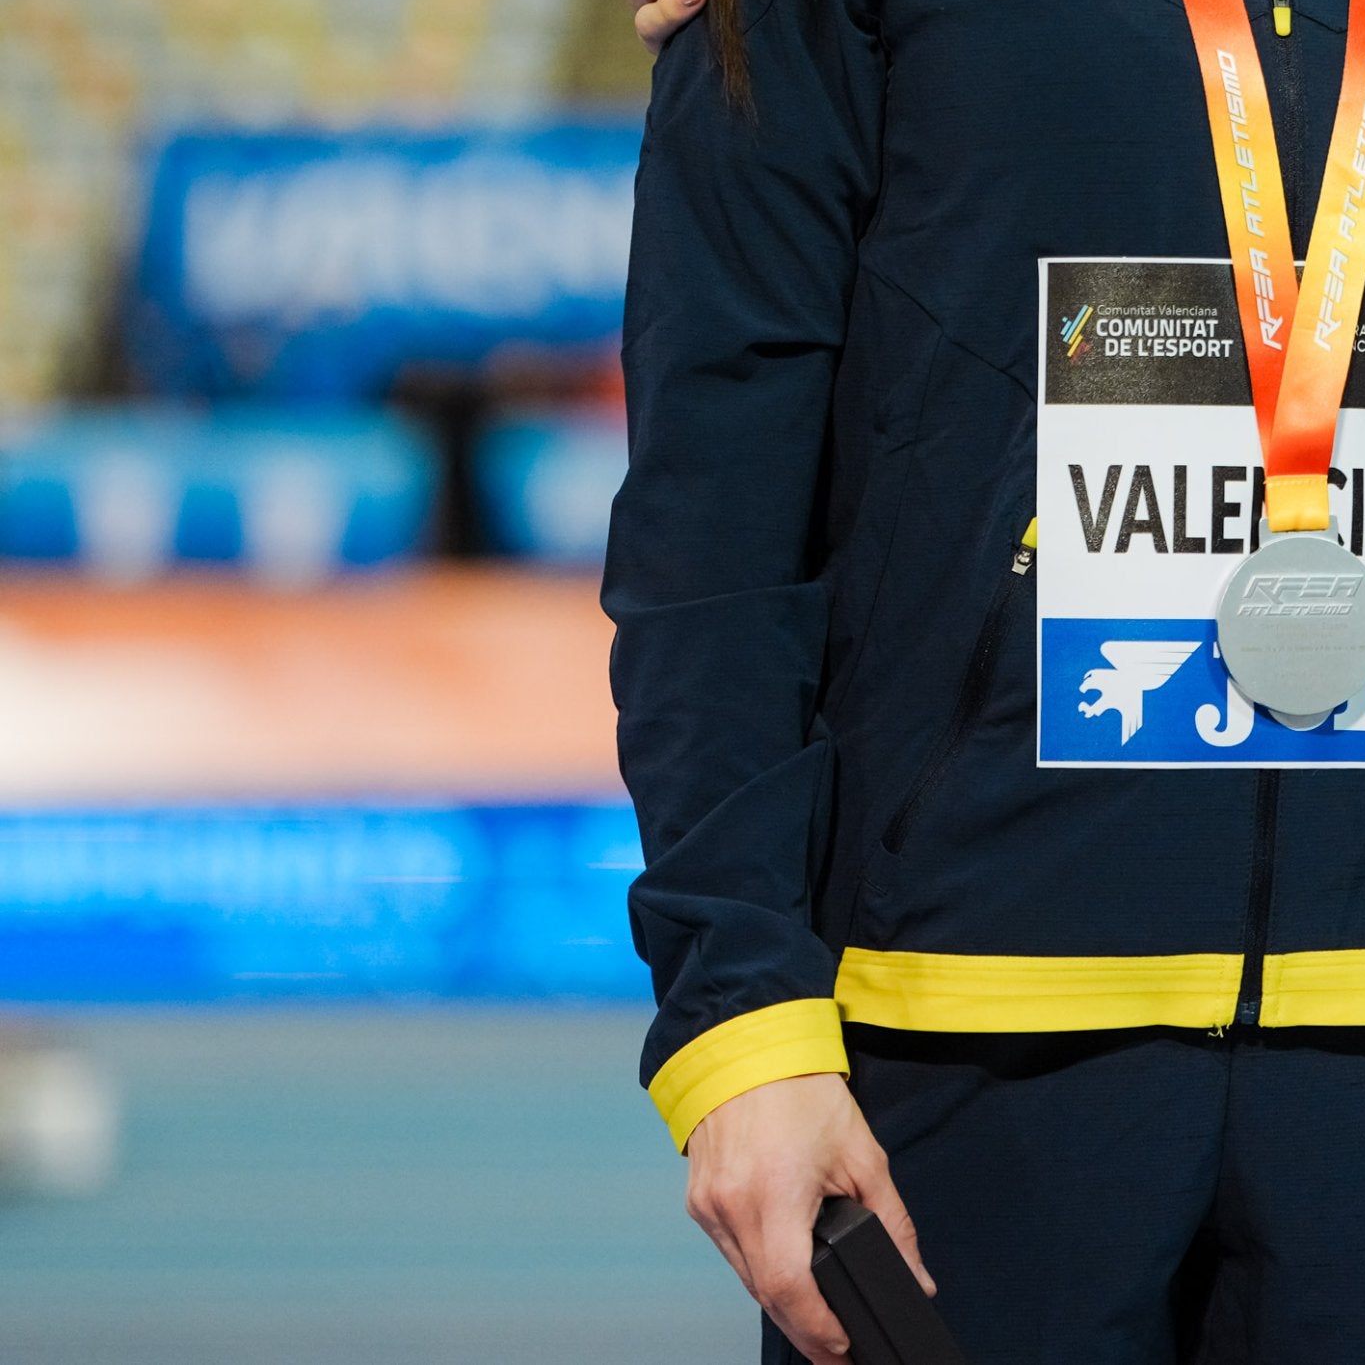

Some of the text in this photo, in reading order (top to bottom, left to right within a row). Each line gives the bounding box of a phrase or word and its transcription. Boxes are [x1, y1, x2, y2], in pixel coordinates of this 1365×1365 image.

[1216, 49, 1266, 237] ATLETISMO
[1097, 305, 1218, 316] Comunitat Valenciana
[1096, 319, 1219, 338] COMUNITAT
[1105, 338, 1234, 358] DE L'ESPORT
[1243, 573, 1364, 605] RFEA
[1237, 603, 1353, 617] ATLETISMO
